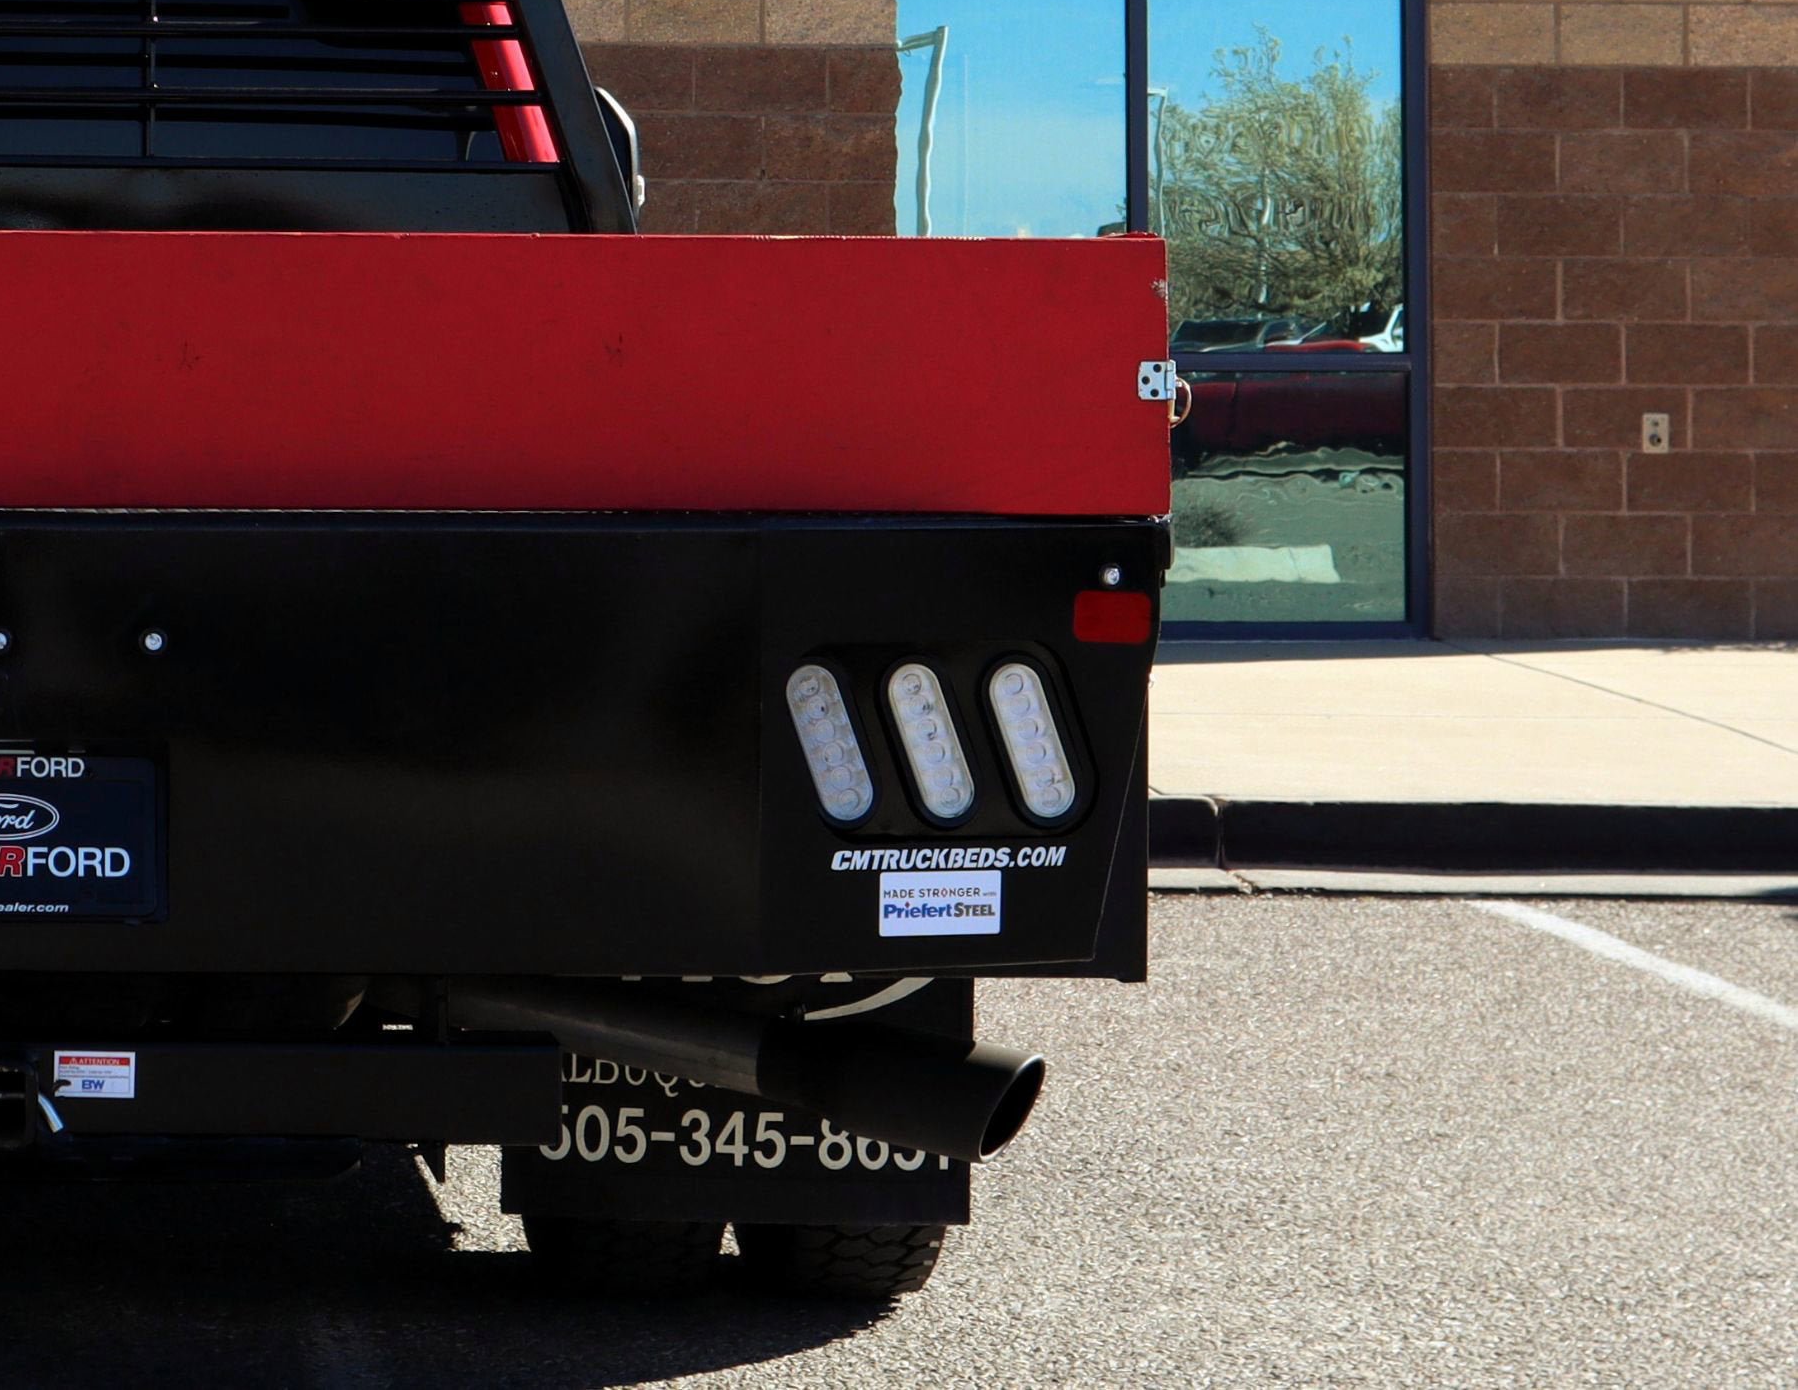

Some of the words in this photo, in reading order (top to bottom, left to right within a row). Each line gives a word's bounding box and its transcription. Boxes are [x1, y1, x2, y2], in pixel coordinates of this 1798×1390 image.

[830, 846, 1067, 871] CMTRUCKBEDS.COM
[883, 888, 915, 899] MADE
[918, 887, 981, 898] STRONGER
[78, 1057, 120, 1066] ATTENTION
[539, 1104, 949, 1170] 505-345-86
